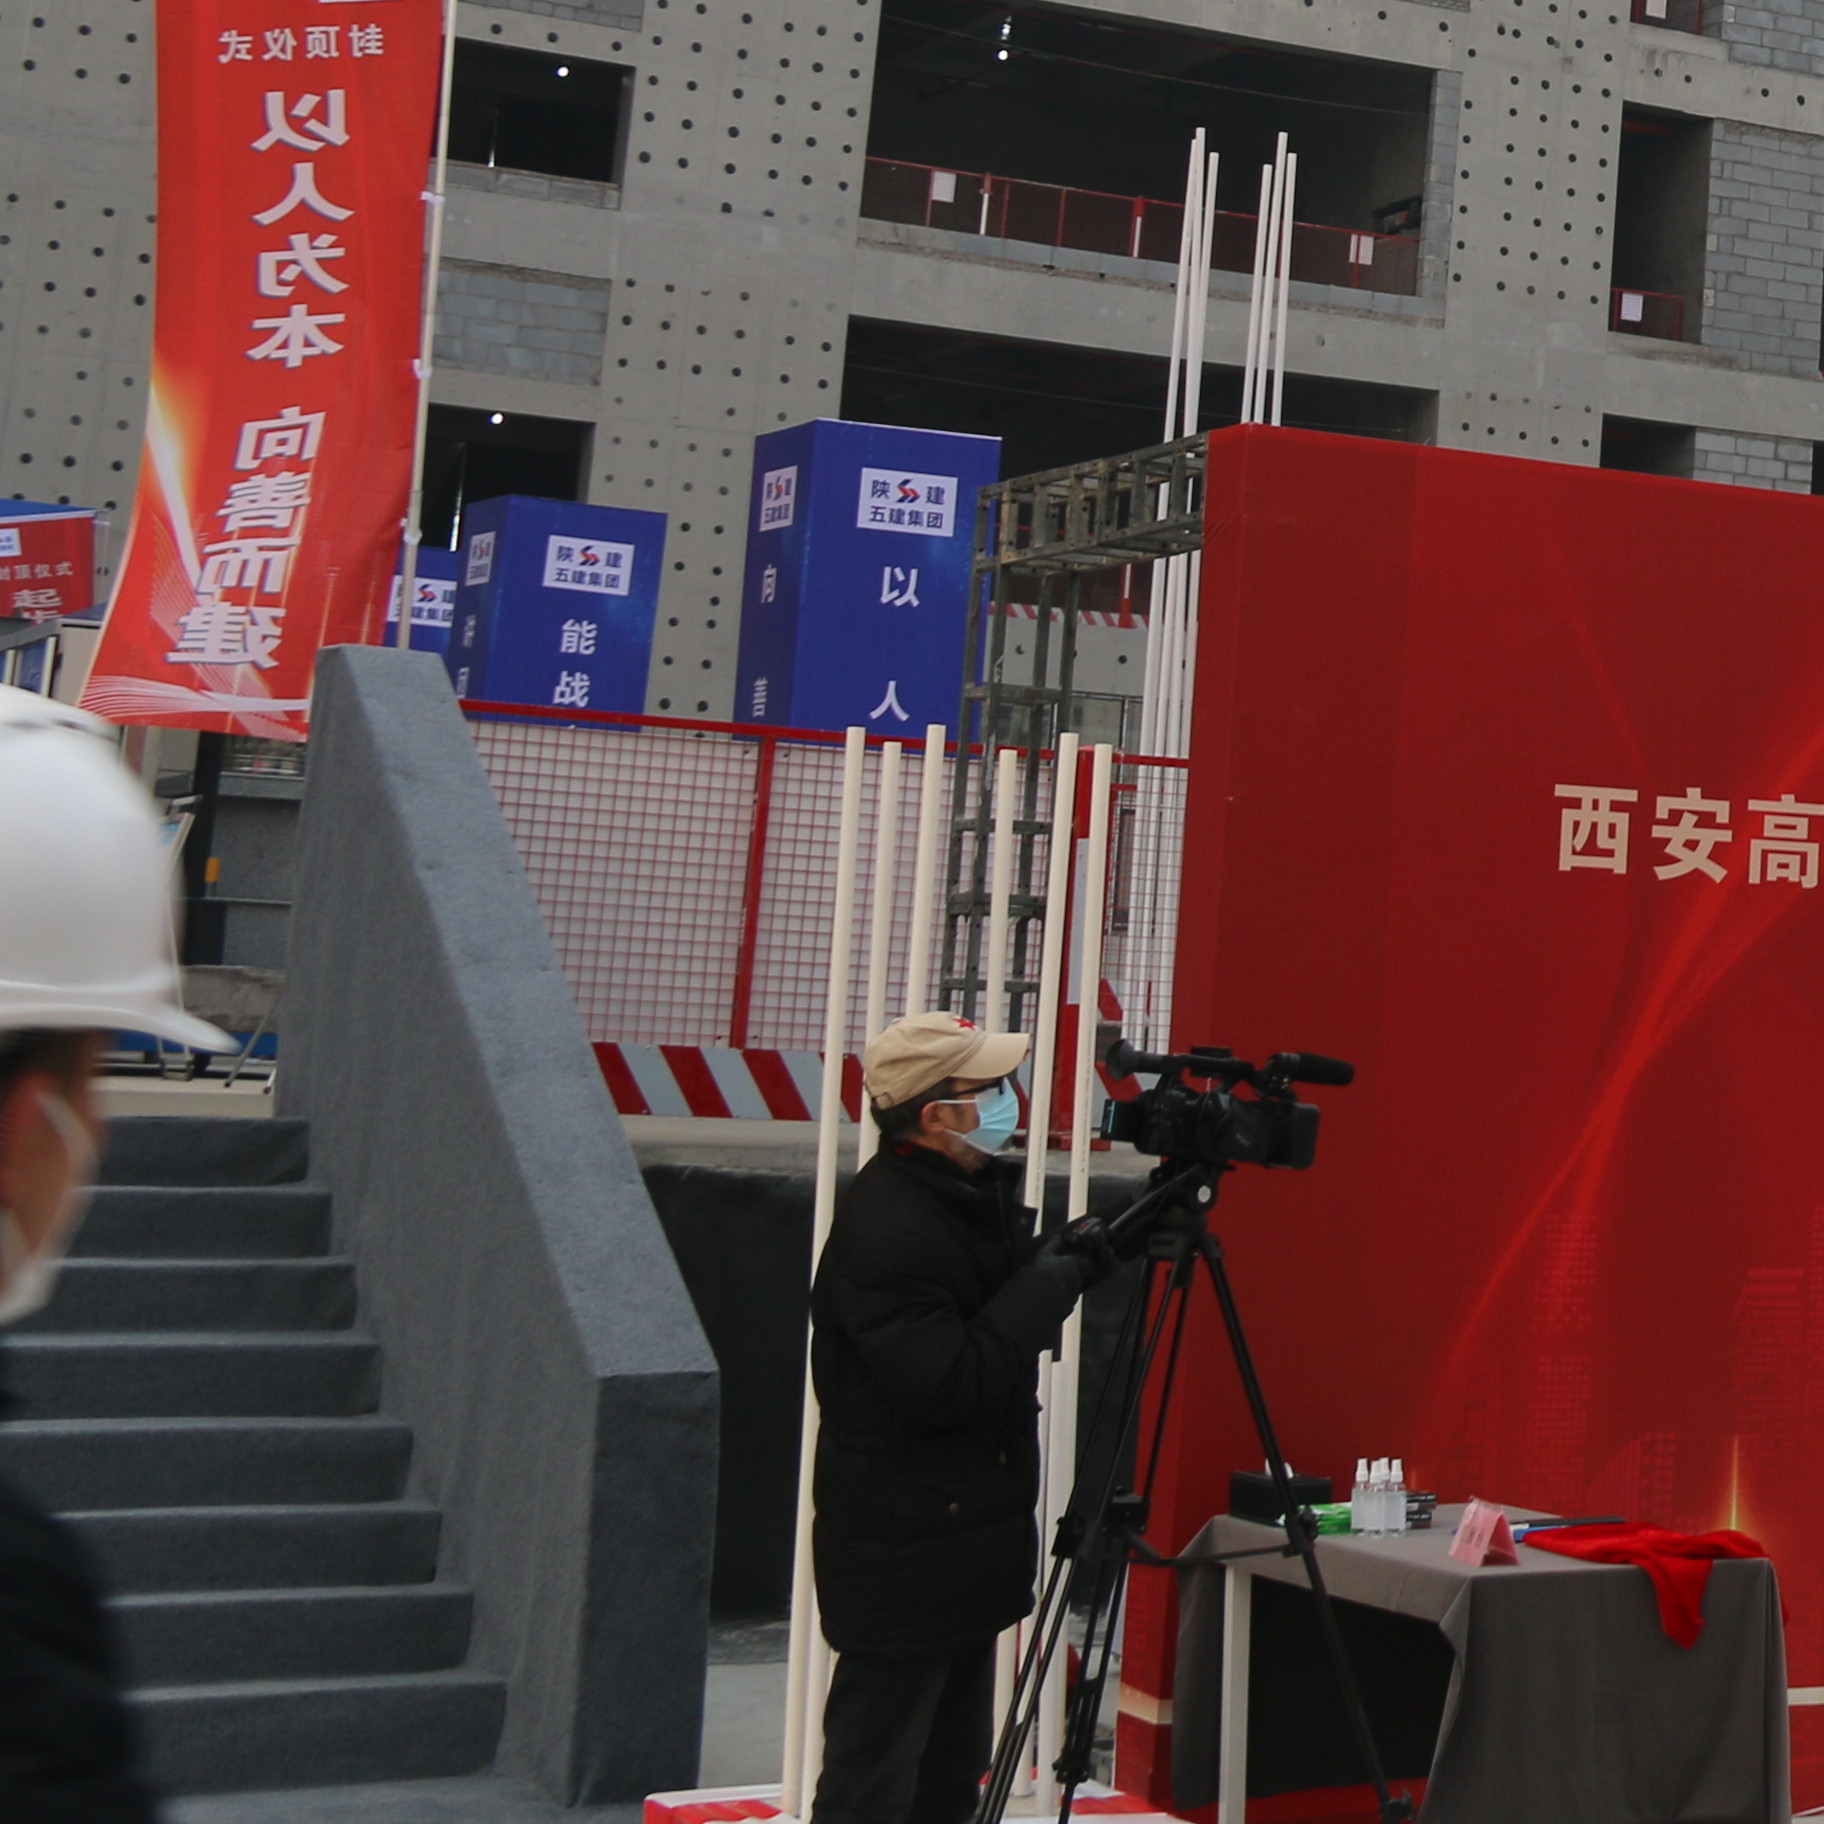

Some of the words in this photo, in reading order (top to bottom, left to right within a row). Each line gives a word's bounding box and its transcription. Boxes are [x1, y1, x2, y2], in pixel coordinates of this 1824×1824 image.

[868, 505, 944, 529] 五建集团
[553, 567, 620, 589] 五建集团
[552, 618, 599, 729] 能战
